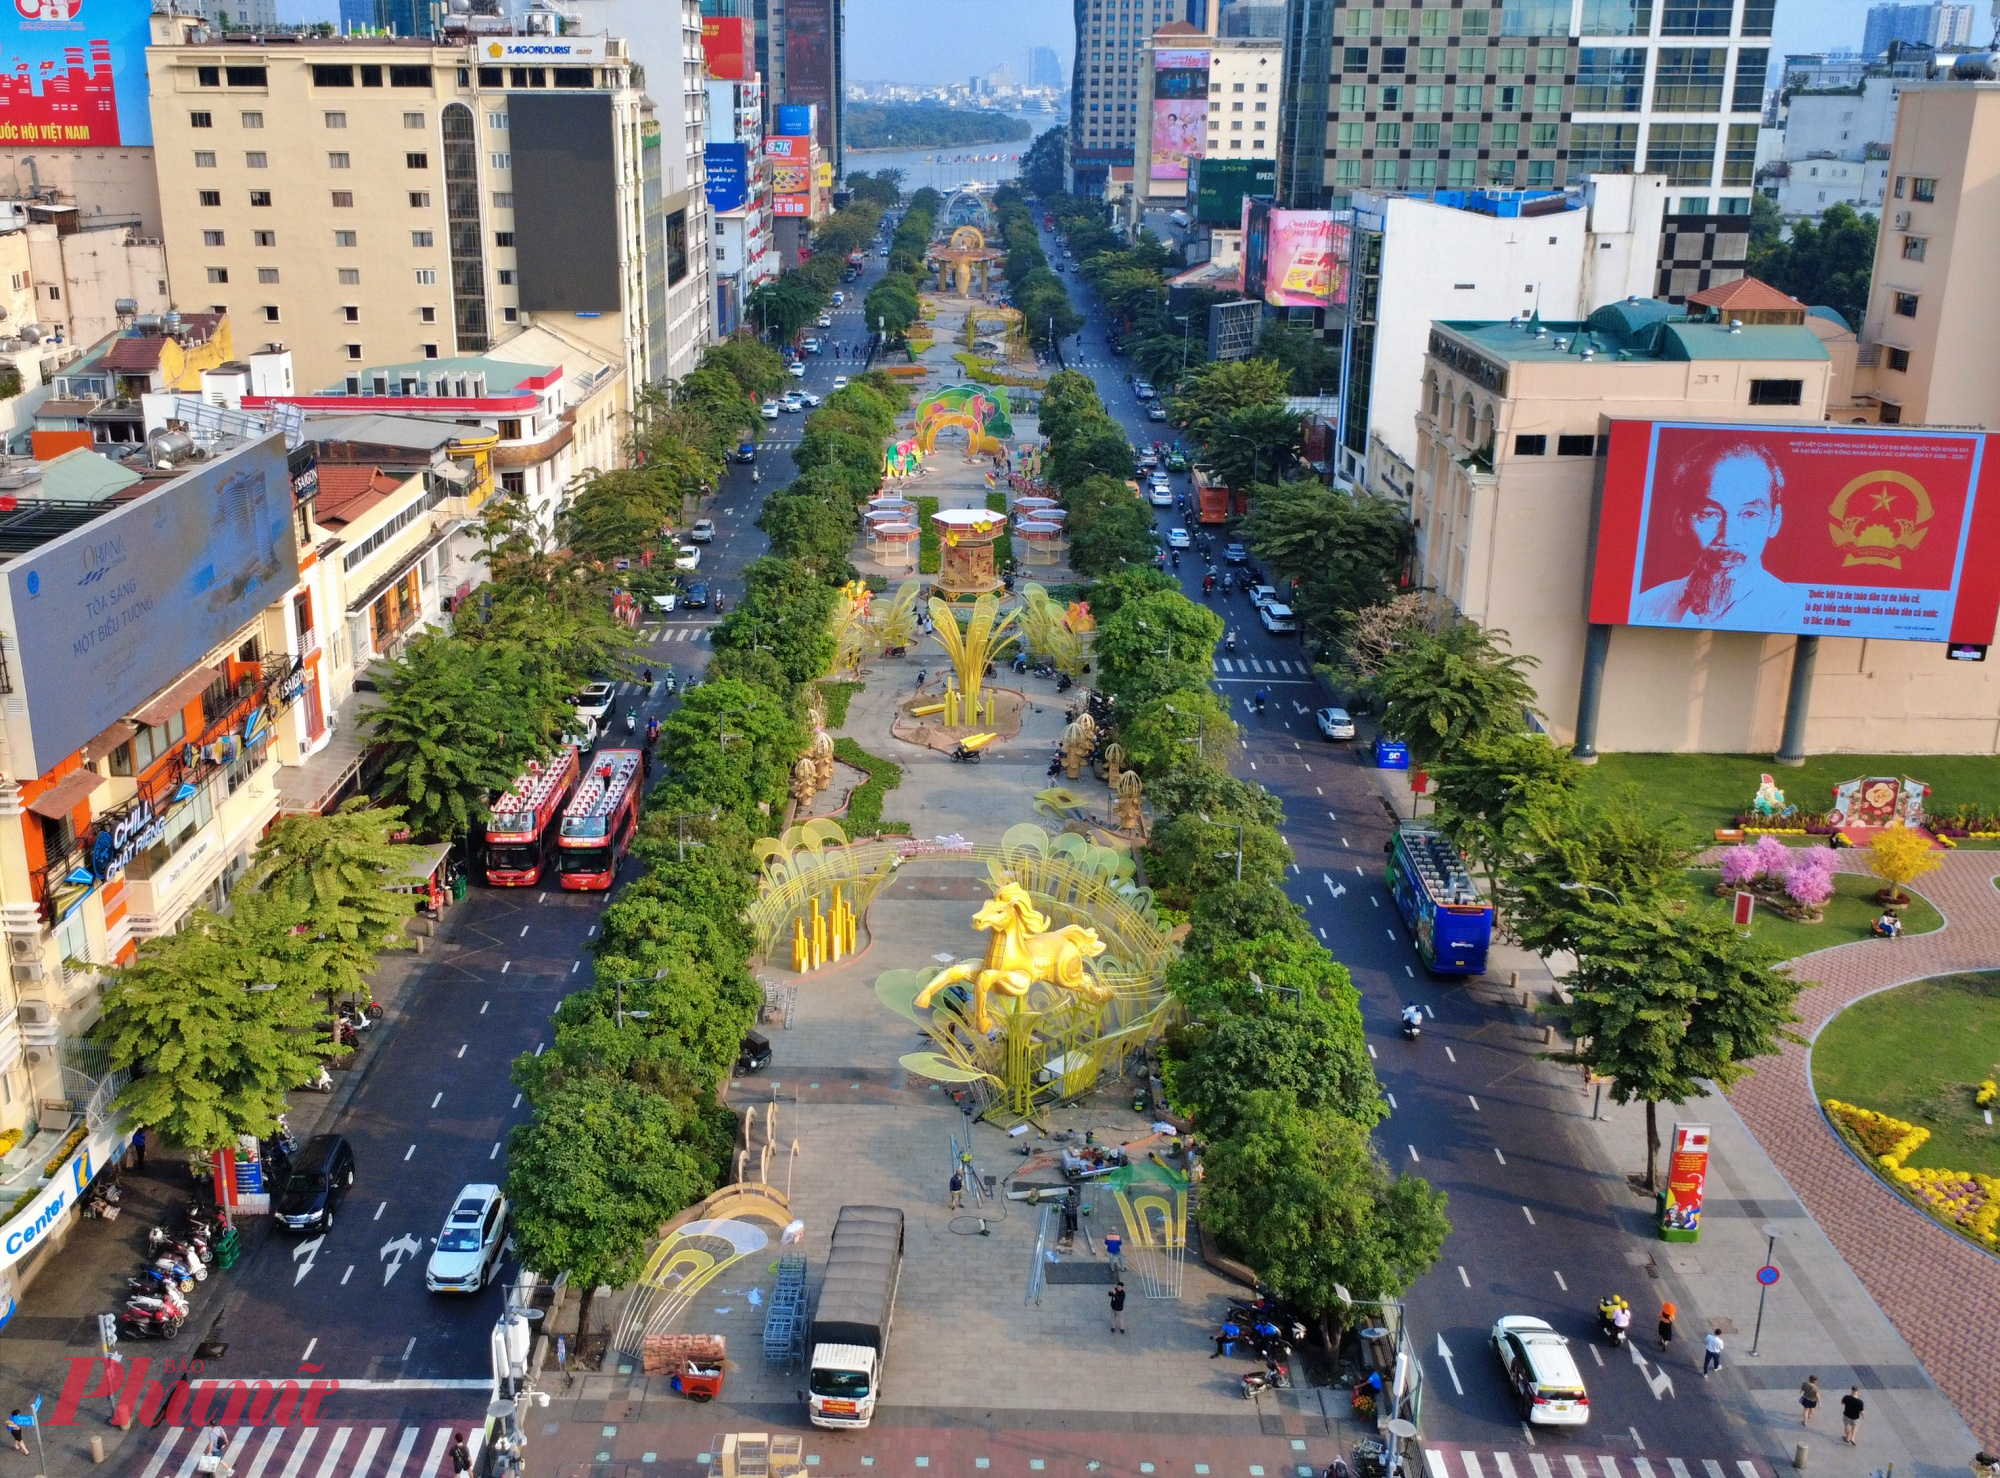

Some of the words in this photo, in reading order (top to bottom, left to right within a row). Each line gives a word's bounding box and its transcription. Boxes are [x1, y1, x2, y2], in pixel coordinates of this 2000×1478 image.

[507, 45, 572, 55] SAIGONTOURIST
[21, 122, 39, 142] HỘI
[40, 122, 63, 142] VIỆT
[65, 125, 91, 140] NAM
[297, 467, 318, 491] SAIGON
[284, 667, 306, 696] SAIGON
[115, 800, 153, 850] CHILL
[107, 841, 135, 882] CHẤT
[136, 816, 167, 855] RIÊNG
[6, 1190, 65, 1255] Center
